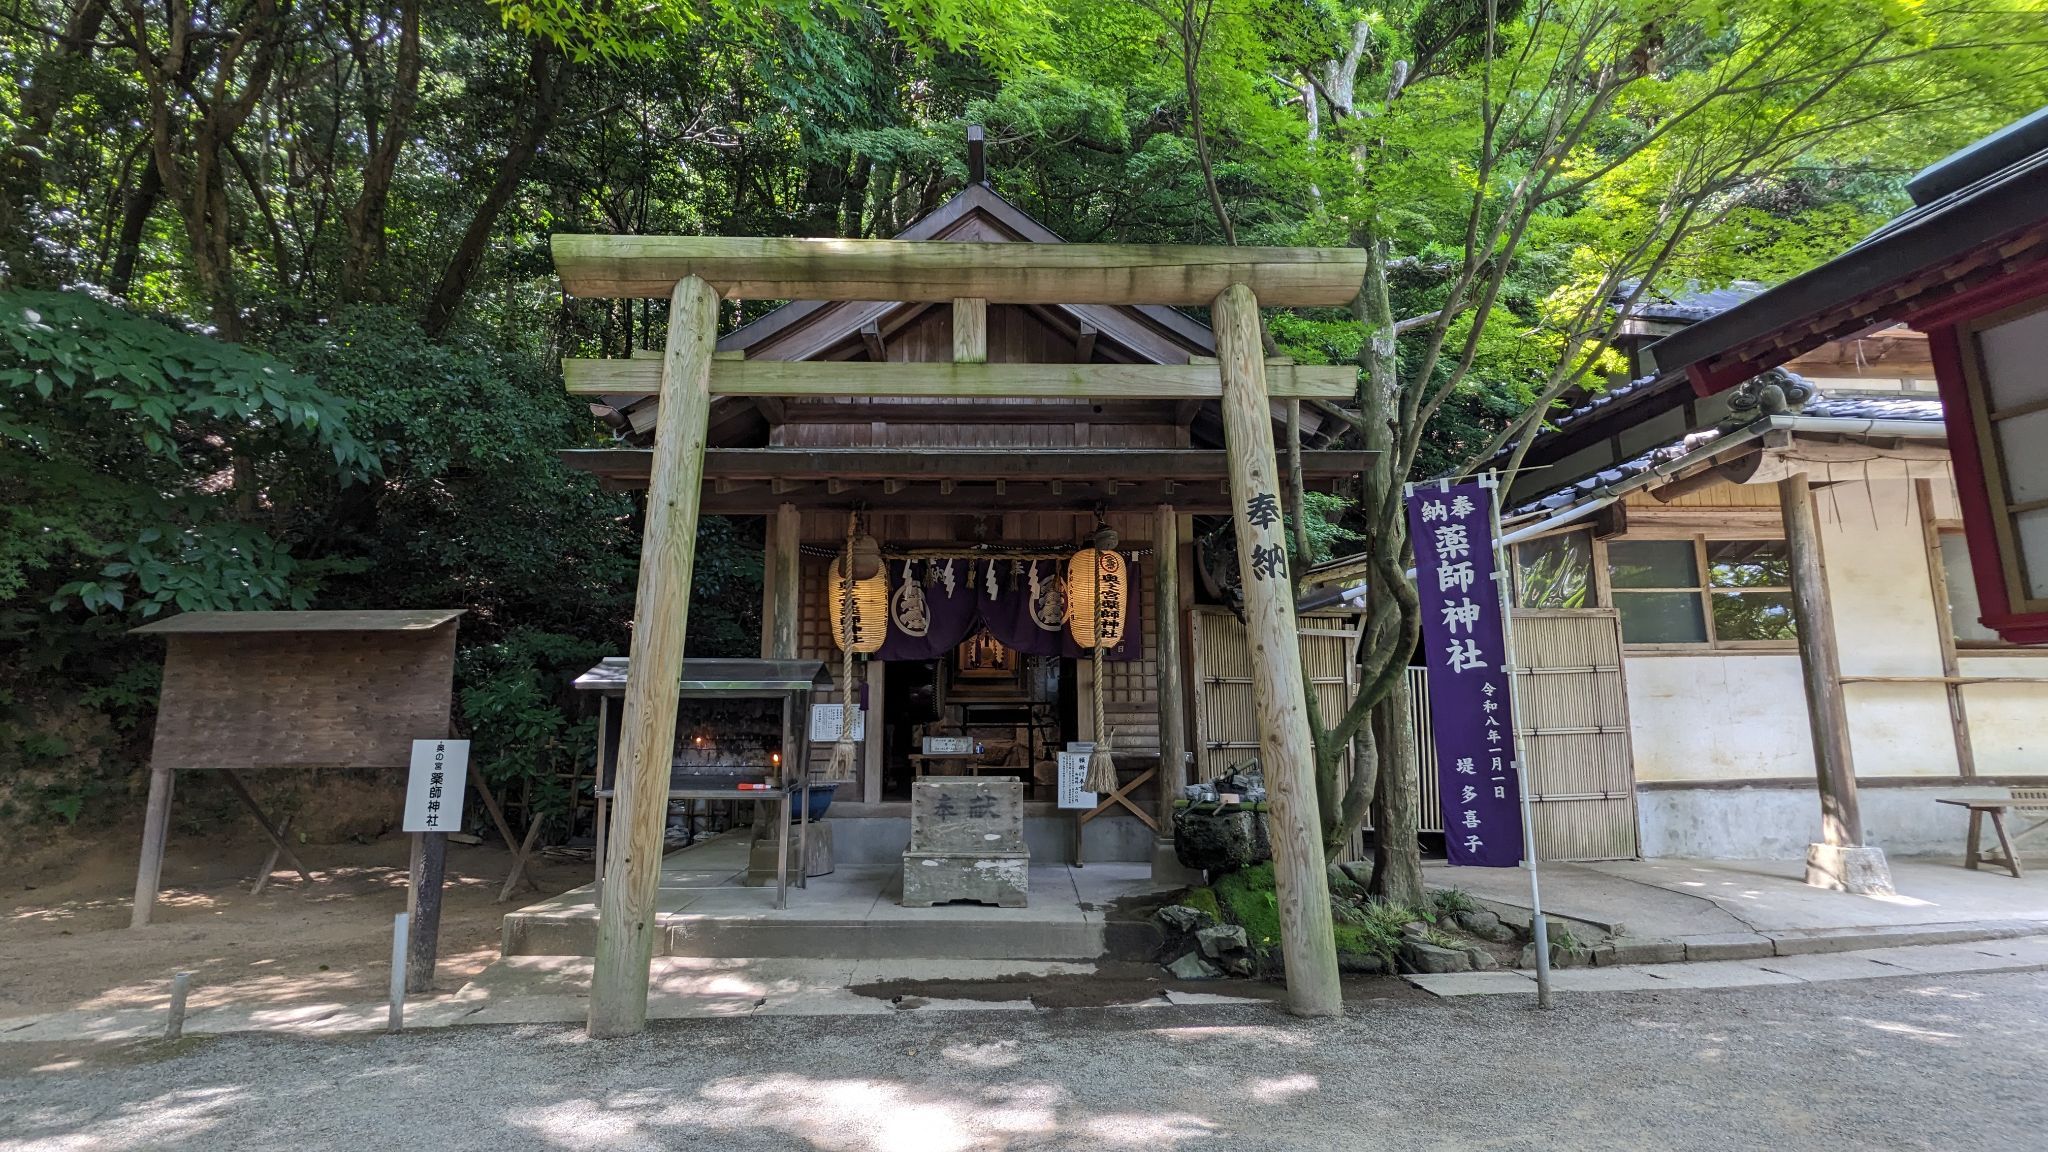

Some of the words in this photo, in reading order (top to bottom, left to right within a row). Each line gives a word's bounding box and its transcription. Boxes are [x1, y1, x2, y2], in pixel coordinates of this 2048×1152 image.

[1246, 492, 1288, 581] 奉納
[1421, 495, 1476, 522] 奉納
[1434, 523, 1489, 674] 薬師神社
[1480, 681, 1506, 799] 令和八年一月一日
[1455, 757, 1484, 854] 堤多喜子
